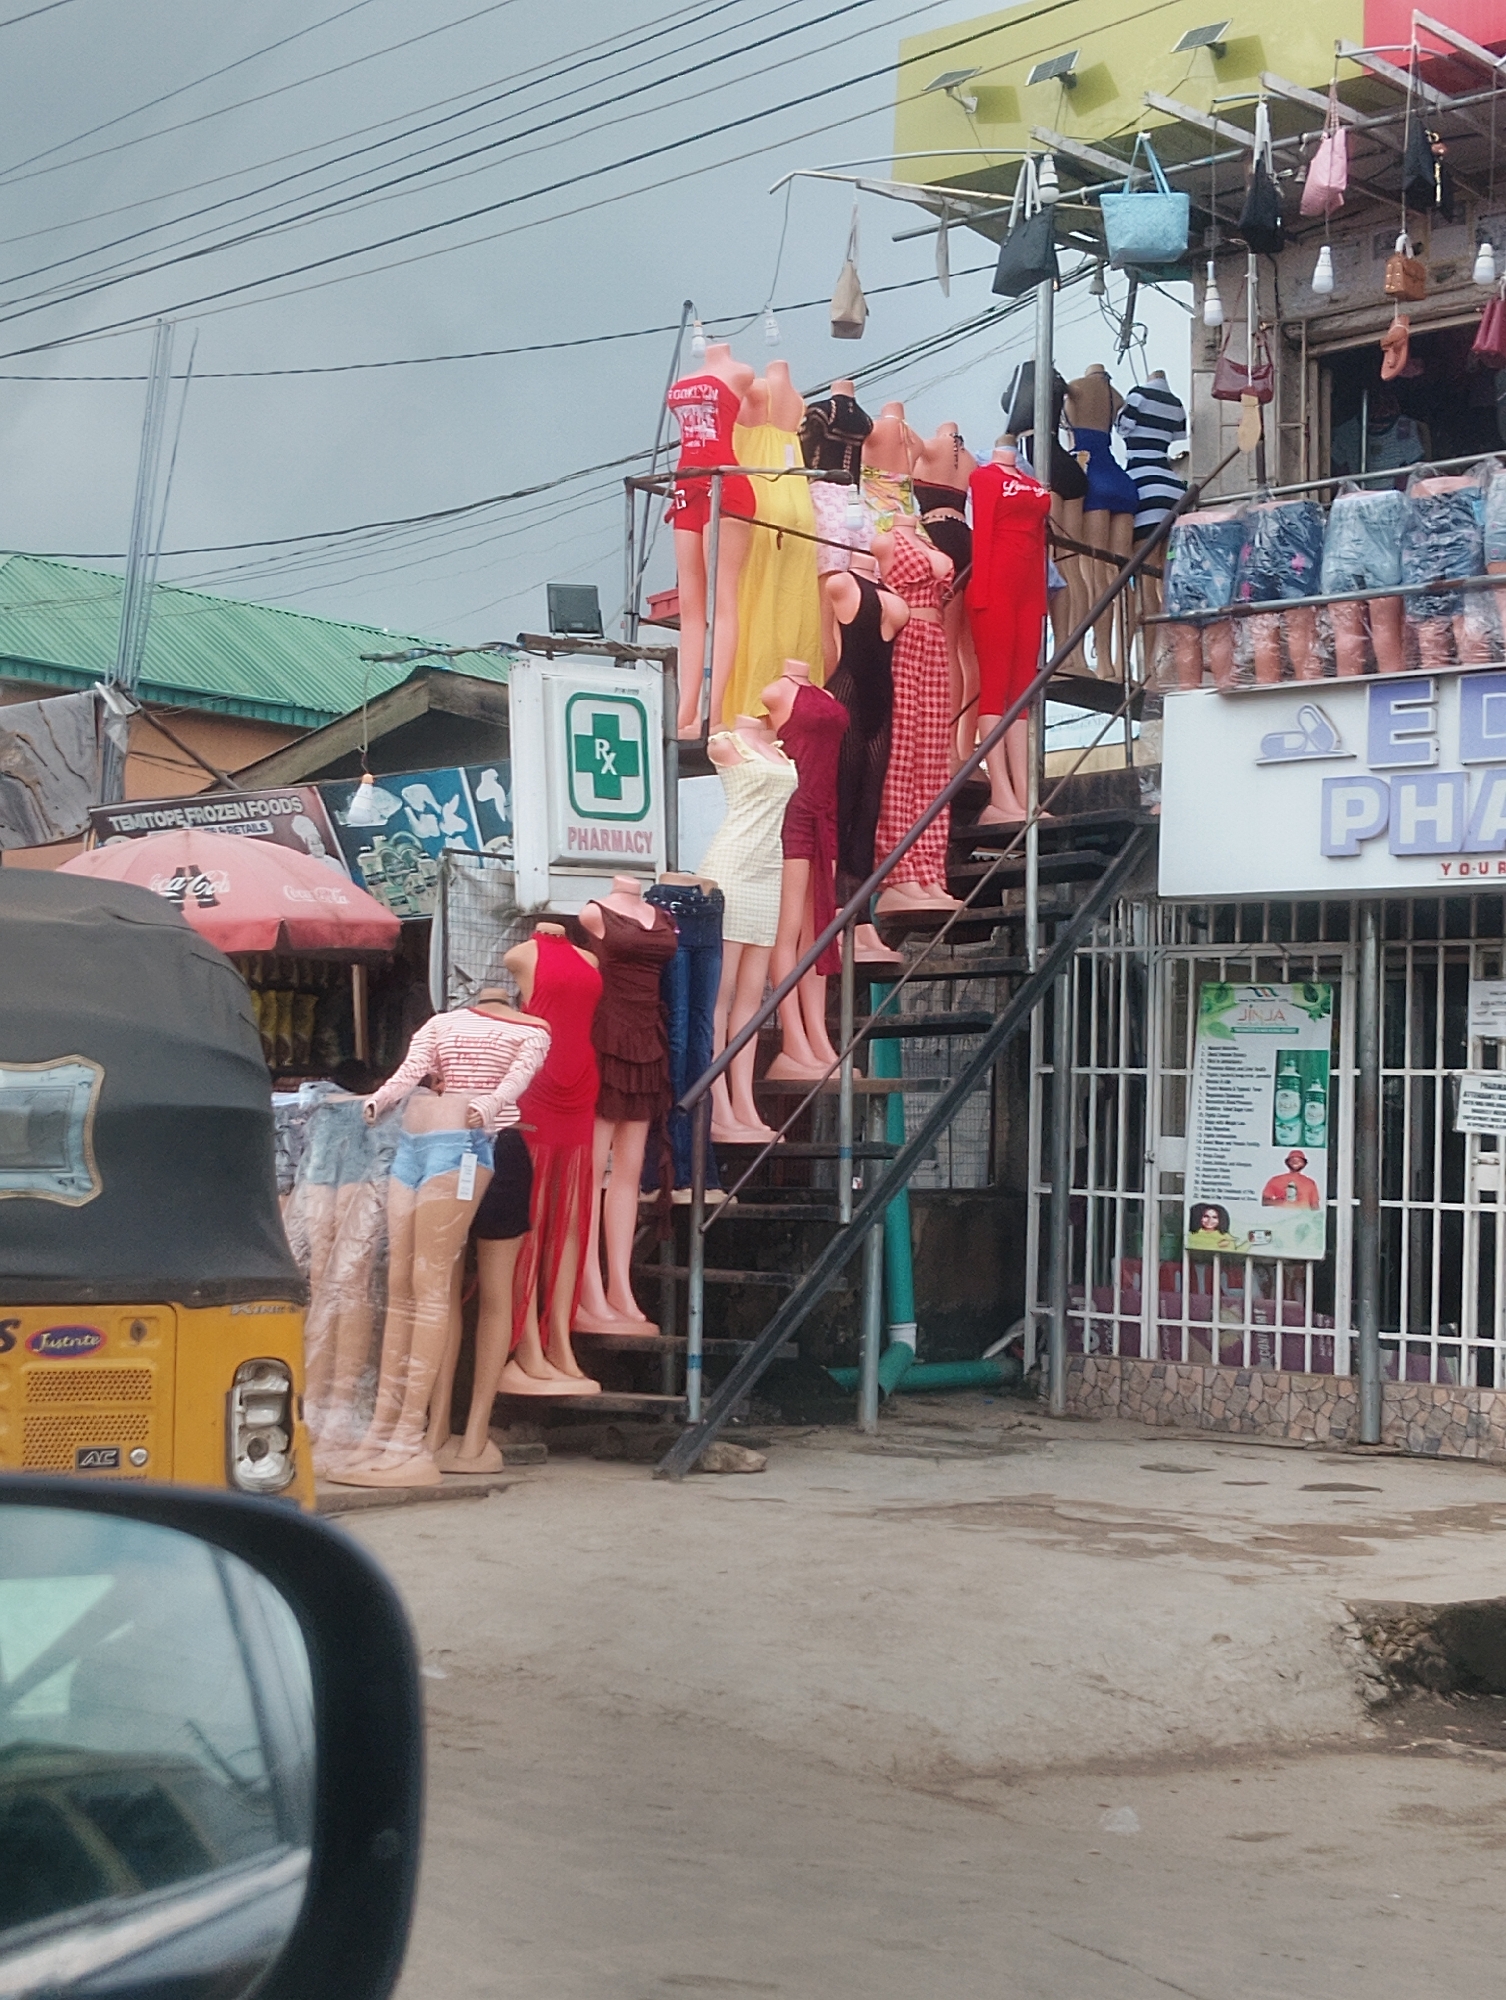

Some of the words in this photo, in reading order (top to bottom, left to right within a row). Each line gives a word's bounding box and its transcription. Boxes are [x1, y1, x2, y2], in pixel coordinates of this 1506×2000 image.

[108, 807, 184, 832] TEMITOPE
[185, 801, 249, 826] FROZEN
[249, 796, 304, 818] FOODS
[226, 822, 268, 835] RETAILS
[568, 826, 653, 854] PHARMACY
[80, 1450, 117, 1466] AC
